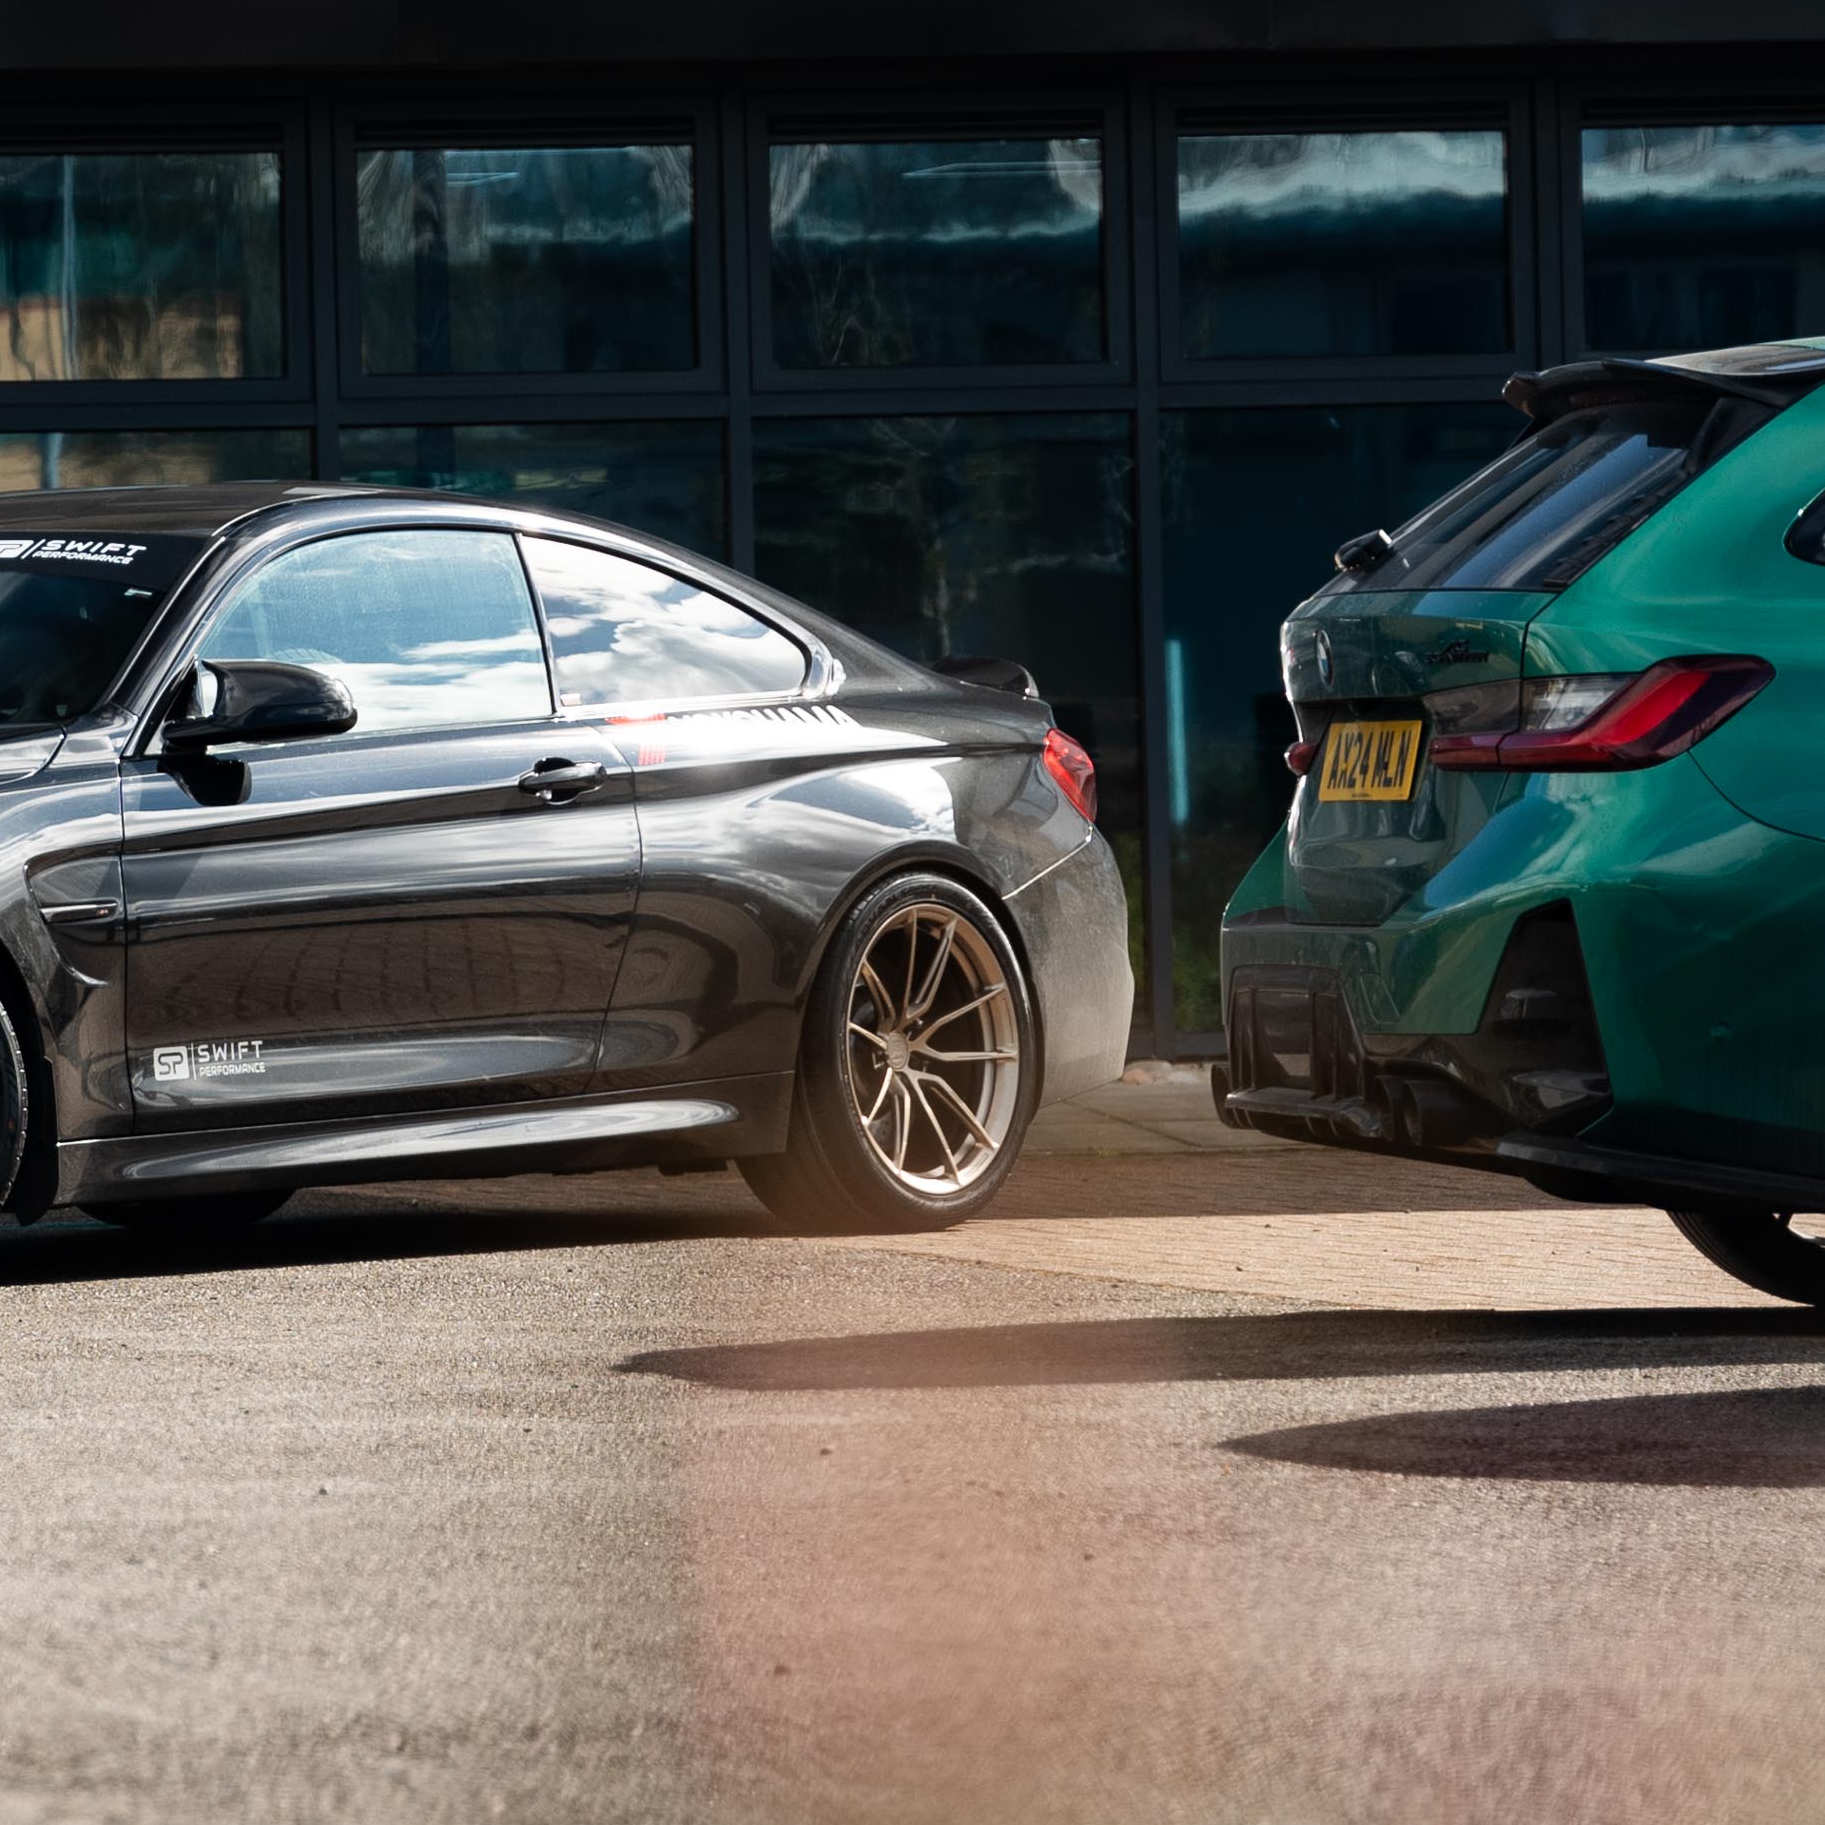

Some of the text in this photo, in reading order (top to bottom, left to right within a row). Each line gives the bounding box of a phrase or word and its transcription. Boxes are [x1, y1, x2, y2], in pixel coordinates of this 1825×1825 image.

[41, 539, 147, 557] SWIFT
[32, 550, 134, 565] PERFORMANCE
[1326, 731, 1374, 790] AX24
[197, 1040, 263, 1062] SWIFT
[199, 1061, 266, 1078] PERFORMANCE
